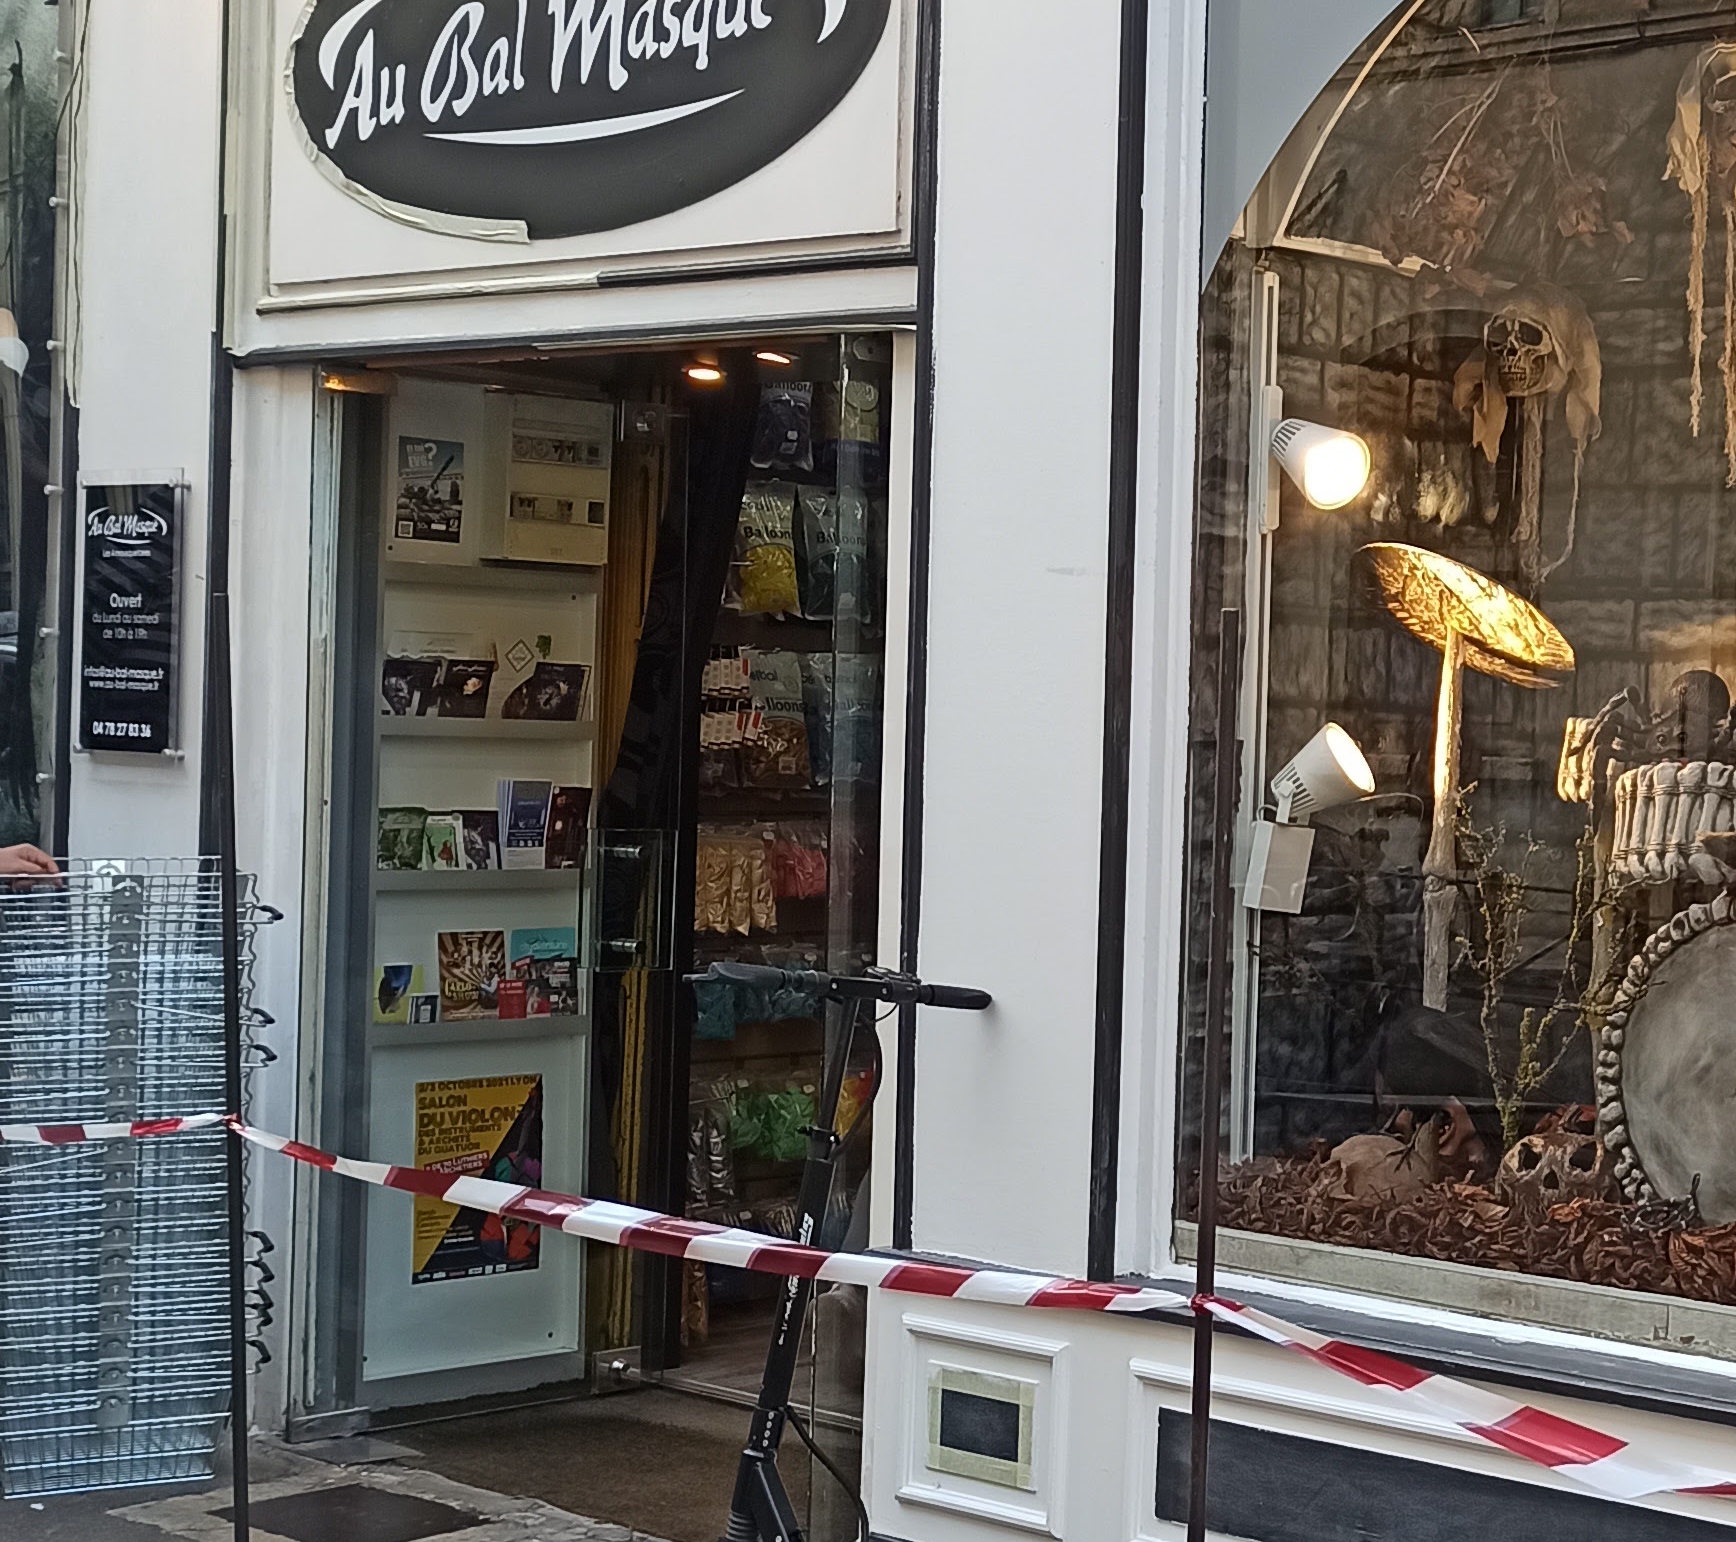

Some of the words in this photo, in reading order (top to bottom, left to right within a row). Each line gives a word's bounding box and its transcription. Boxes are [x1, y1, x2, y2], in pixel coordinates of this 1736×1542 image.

[324, 28, 406, 149] Au
[109, 592, 142, 608] Ouvert
[93, 721, 104, 735] 04
[105, 722, 115, 736] 78
[116, 722, 128, 736] 27
[438, 1079, 483, 1091] OCTOBRE
[508, 1075, 536, 1086] LYON
[418, 1094, 468, 1110] SALON
[418, 1111, 445, 1128] DU
[448, 1106, 516, 1126] VIOLON
[418, 1146, 432, 1156] DU
[434, 1142, 480, 1154] QUATUOR
